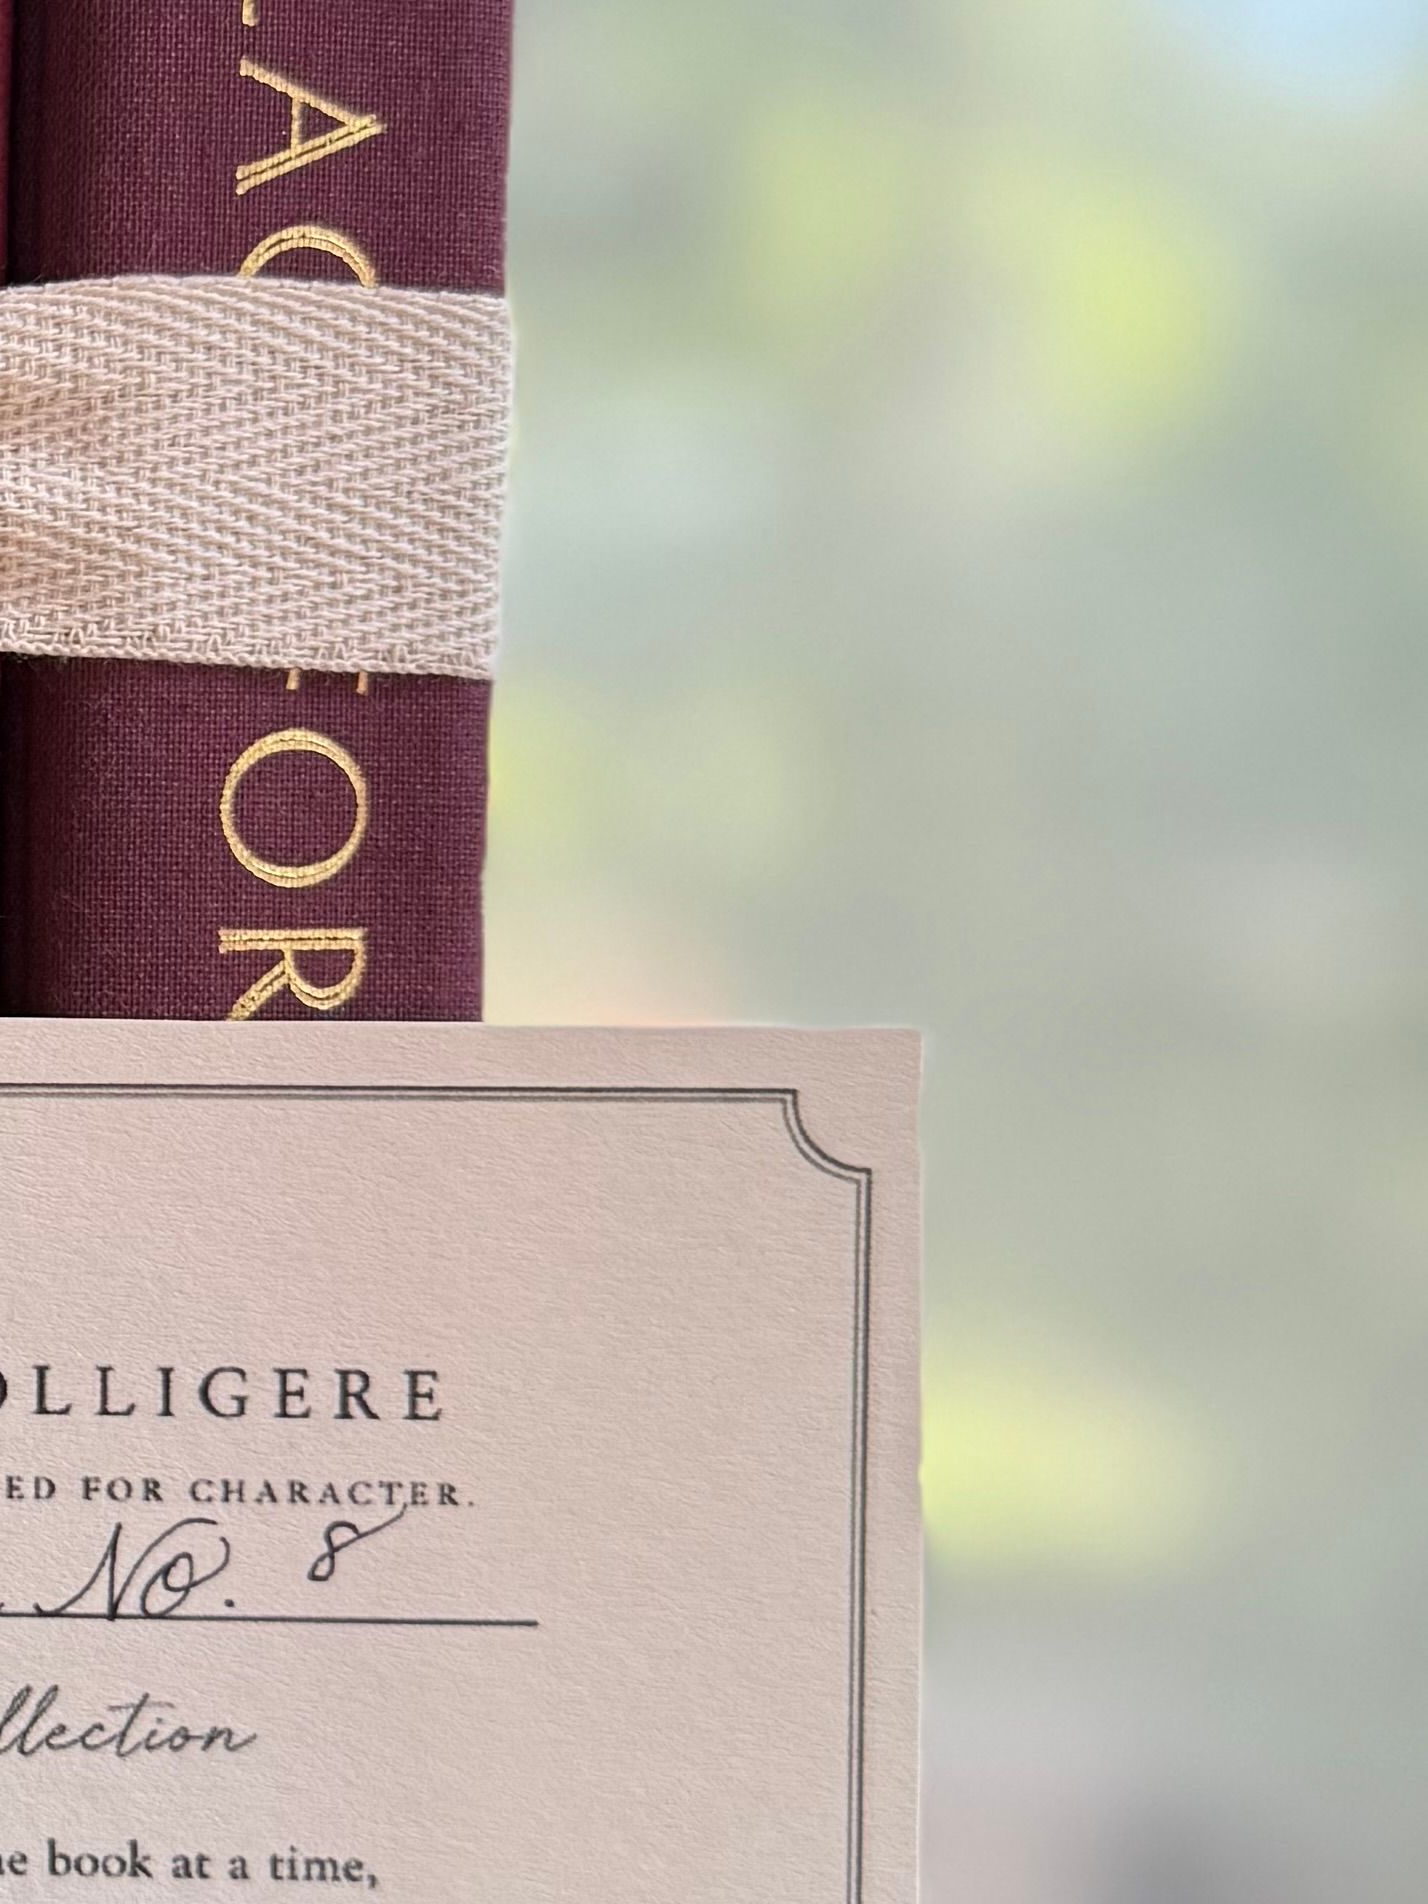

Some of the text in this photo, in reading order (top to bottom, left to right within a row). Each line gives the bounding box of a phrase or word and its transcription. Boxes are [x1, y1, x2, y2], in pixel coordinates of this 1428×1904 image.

[216, 667, 370, 1021] OR
[82, 1476, 163, 1502] FOR
[189, 1479, 473, 1510] CHARACTER.
[47, 1838, 153, 1878] book
[172, 1853, 211, 1880] at
[229, 1856, 250, 1880] a
[270, 1846, 378, 1889] time,
